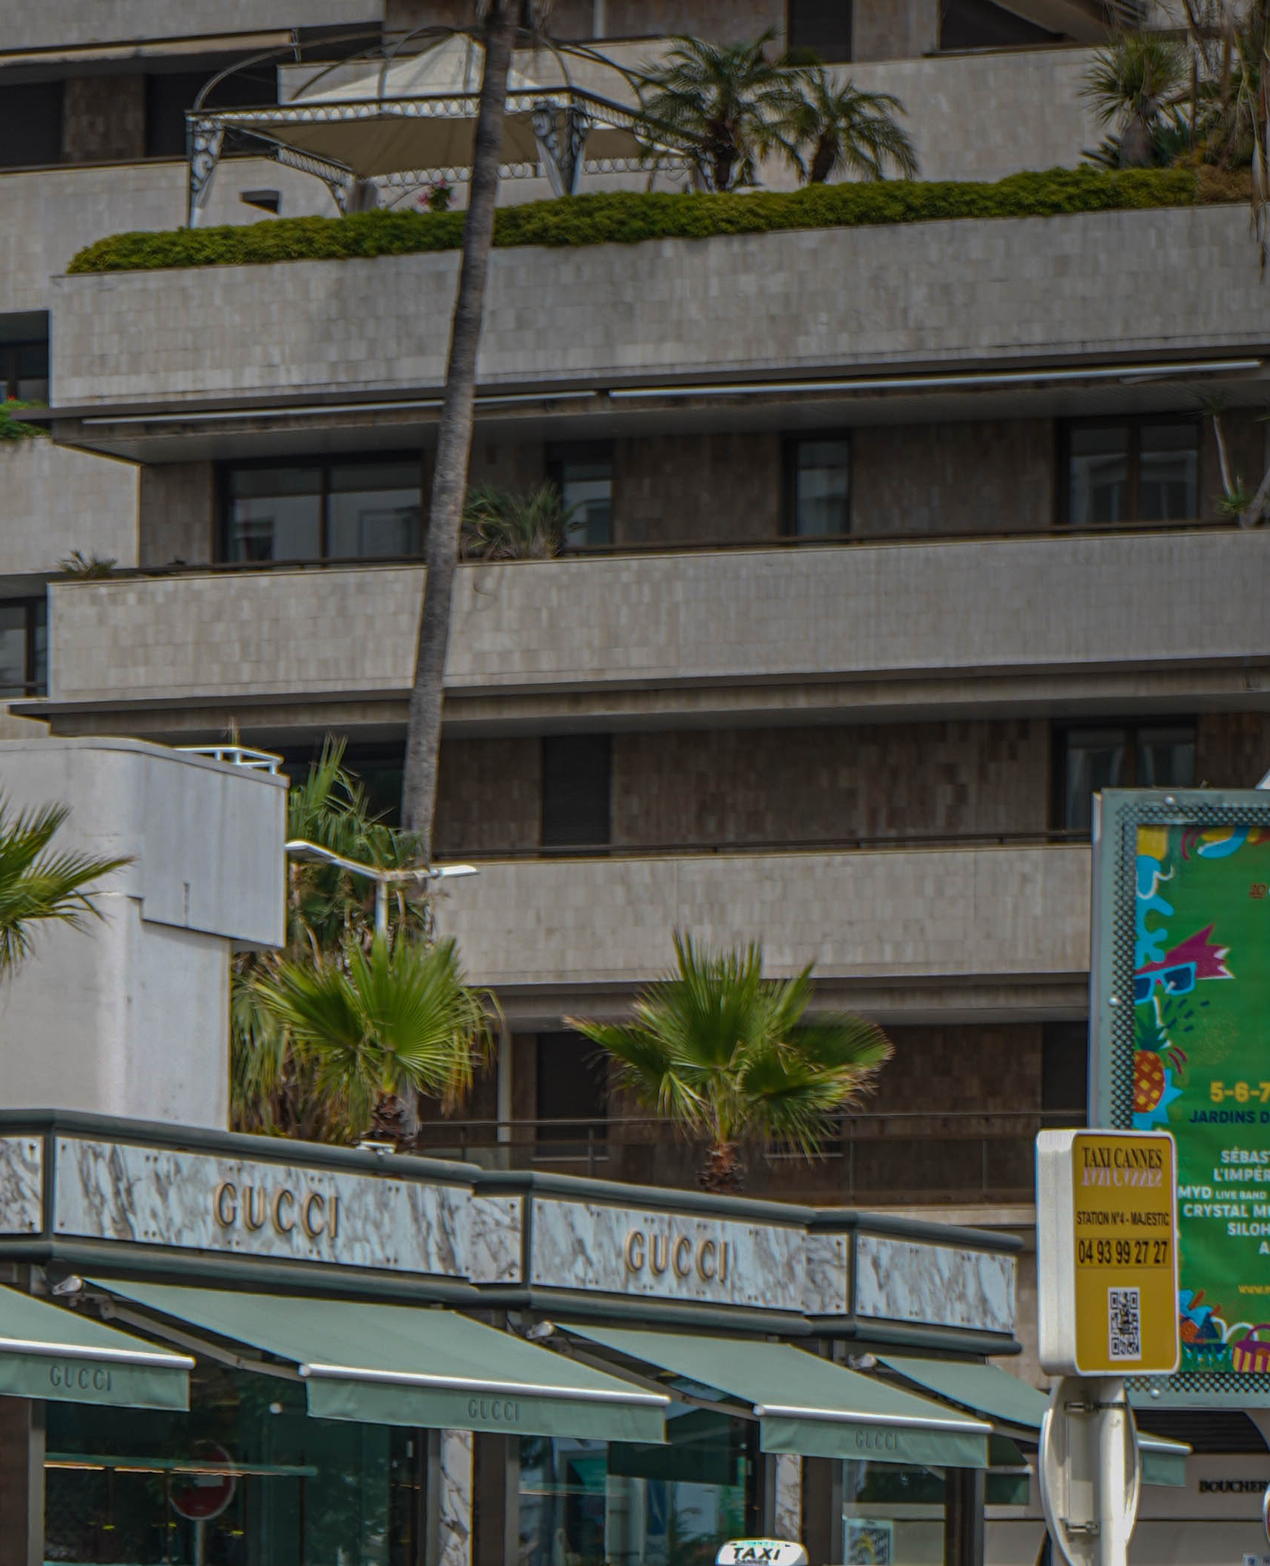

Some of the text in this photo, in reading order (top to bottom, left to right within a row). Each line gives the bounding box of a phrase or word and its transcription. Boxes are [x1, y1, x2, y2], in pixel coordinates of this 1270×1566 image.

[1210, 1081, 1270, 1103] 5-6-7
[1189, 1110, 1256, 1123] JARDINS
[1082, 1147, 1163, 1169] TAXI CANNES
[1220, 1146, 1270, 1164] SÉBAS
[1178, 1186, 1267, 1200] MYD LIVE BAND
[214, 1182, 339, 1239] GUCCI
[1077, 1211, 1109, 1225] STATION
[1131, 1211, 1170, 1226] MAJESTIC
[1183, 1203, 1249, 1217] CRYSTAL
[625, 1228, 730, 1283] GUCCI
[1078, 1241, 1168, 1264] 04 93 99 27 27
[50, 1365, 112, 1391] GUCCI
[468, 1399, 520, 1422] GUCCI
[855, 1429, 898, 1450] GUCCI
[733, 1547, 781, 1560] TAXI
